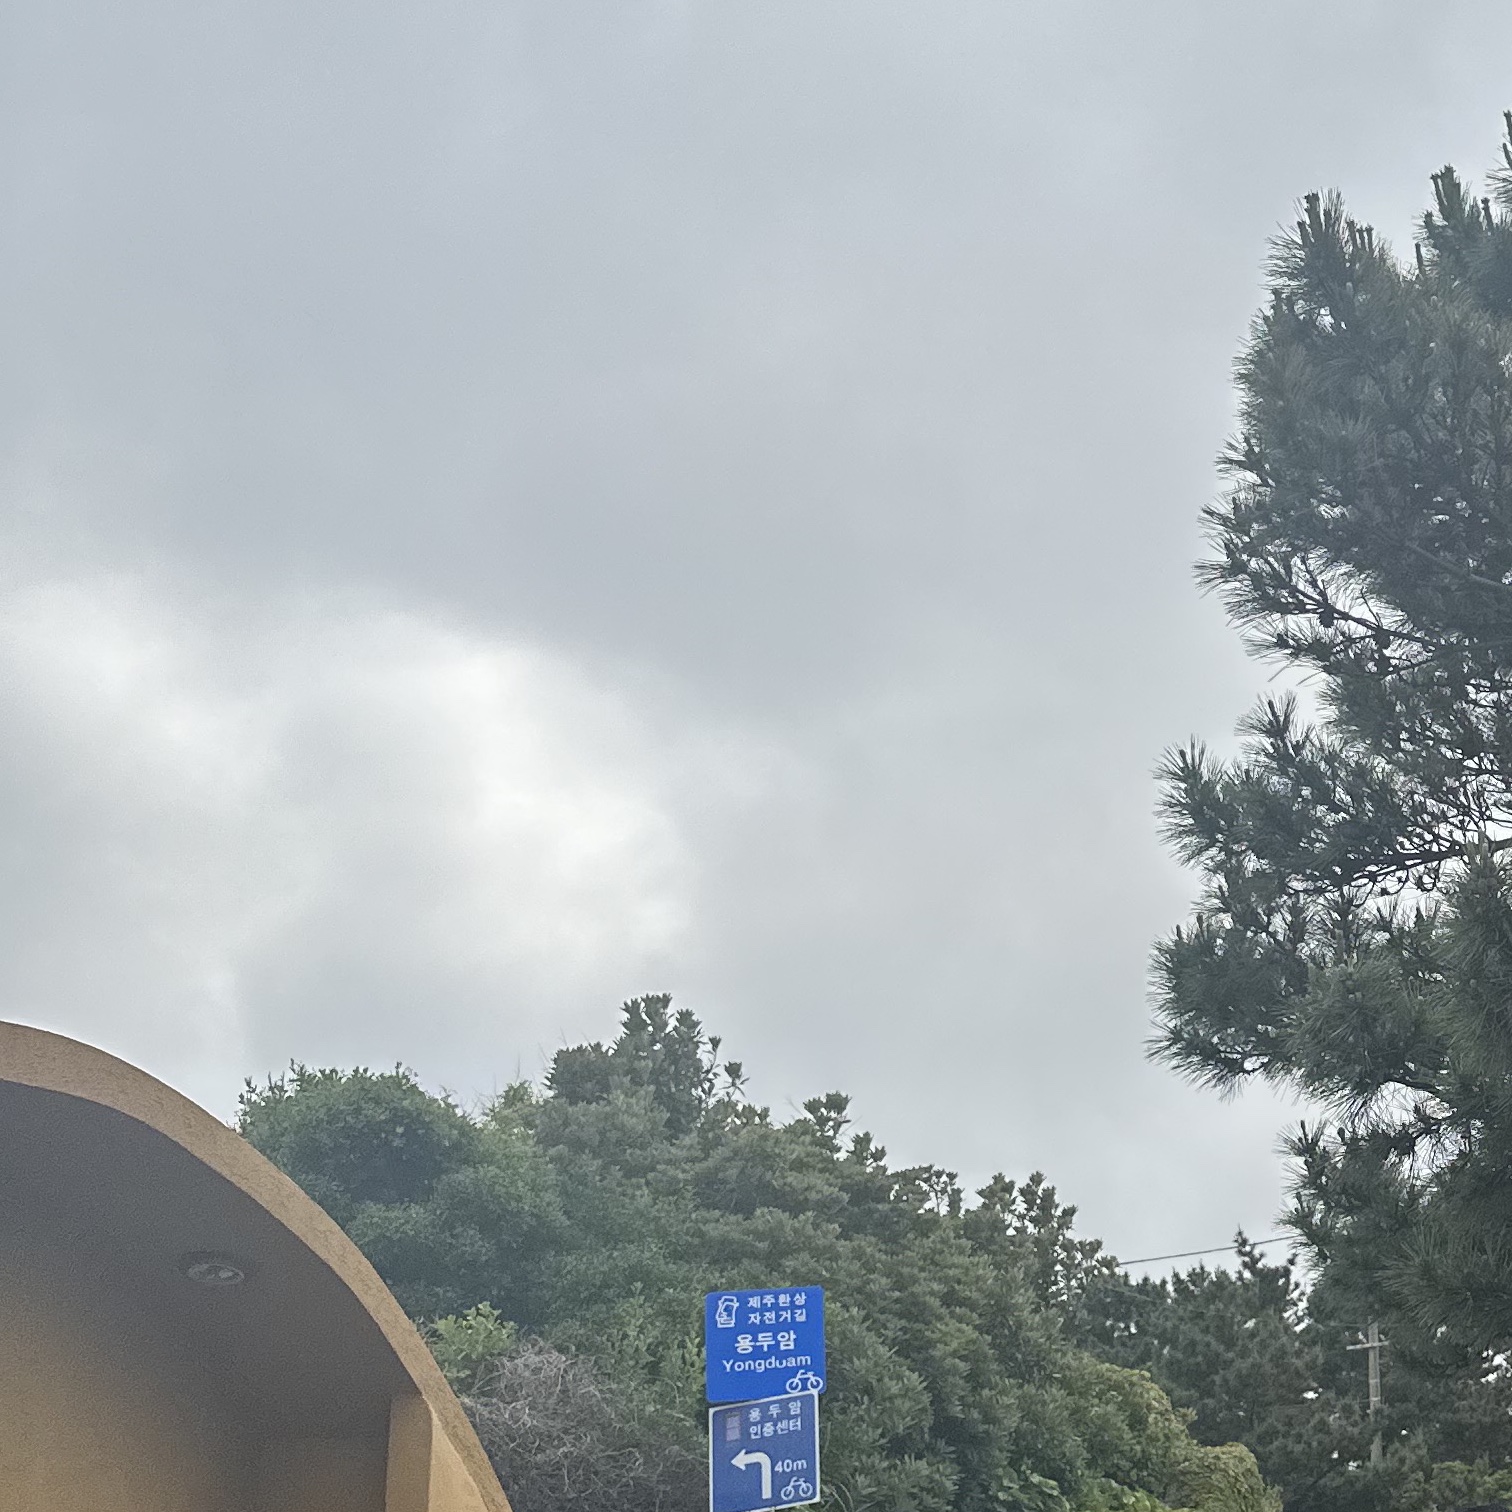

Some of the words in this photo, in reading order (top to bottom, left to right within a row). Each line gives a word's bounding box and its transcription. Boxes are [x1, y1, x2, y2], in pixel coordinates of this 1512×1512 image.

[747, 1292, 807, 1309] 제주환상
[748, 1308, 807, 1325] 자전거길
[735, 1330, 797, 1354] 용두암
[722, 1355, 811, 1373] Yongduam
[749, 1417, 802, 1440] 인증센터
[774, 1458, 807, 1473] 40m
